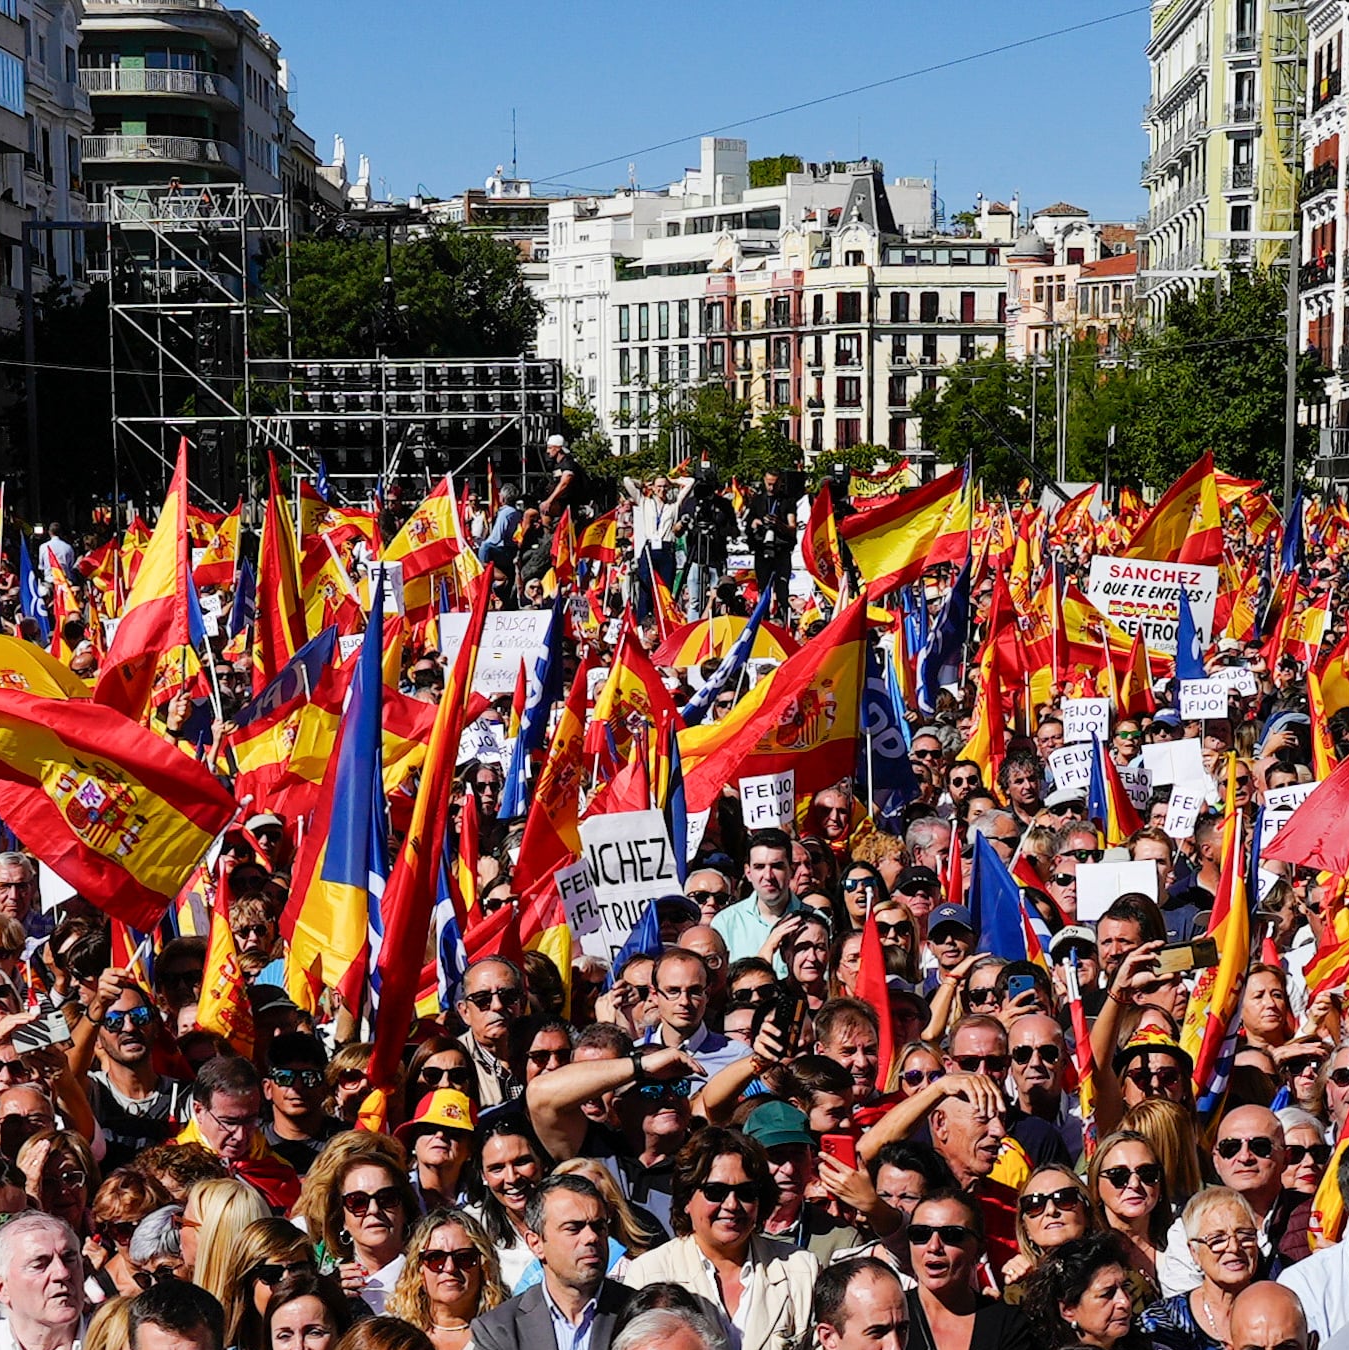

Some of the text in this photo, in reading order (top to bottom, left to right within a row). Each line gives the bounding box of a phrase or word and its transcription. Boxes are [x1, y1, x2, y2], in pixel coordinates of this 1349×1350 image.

[1110, 562, 1201, 585] SÁNCHEZ
[1103, 581, 1129, 596] QUE
[1131, 584, 1147, 598] TE
[1108, 599, 1180, 622] ESPAÑ
[495, 615, 537, 632] BUSCA
[1142, 622, 1204, 644] TROA
[1182, 683, 1227, 697] FEIJO,
[1064, 704, 1107, 718] FEIJO,
[1184, 699, 1224, 715] ¡FIJO!
[1060, 769, 1092, 787] ¡FIJ
[589, 837, 673, 887] NCHEZ
